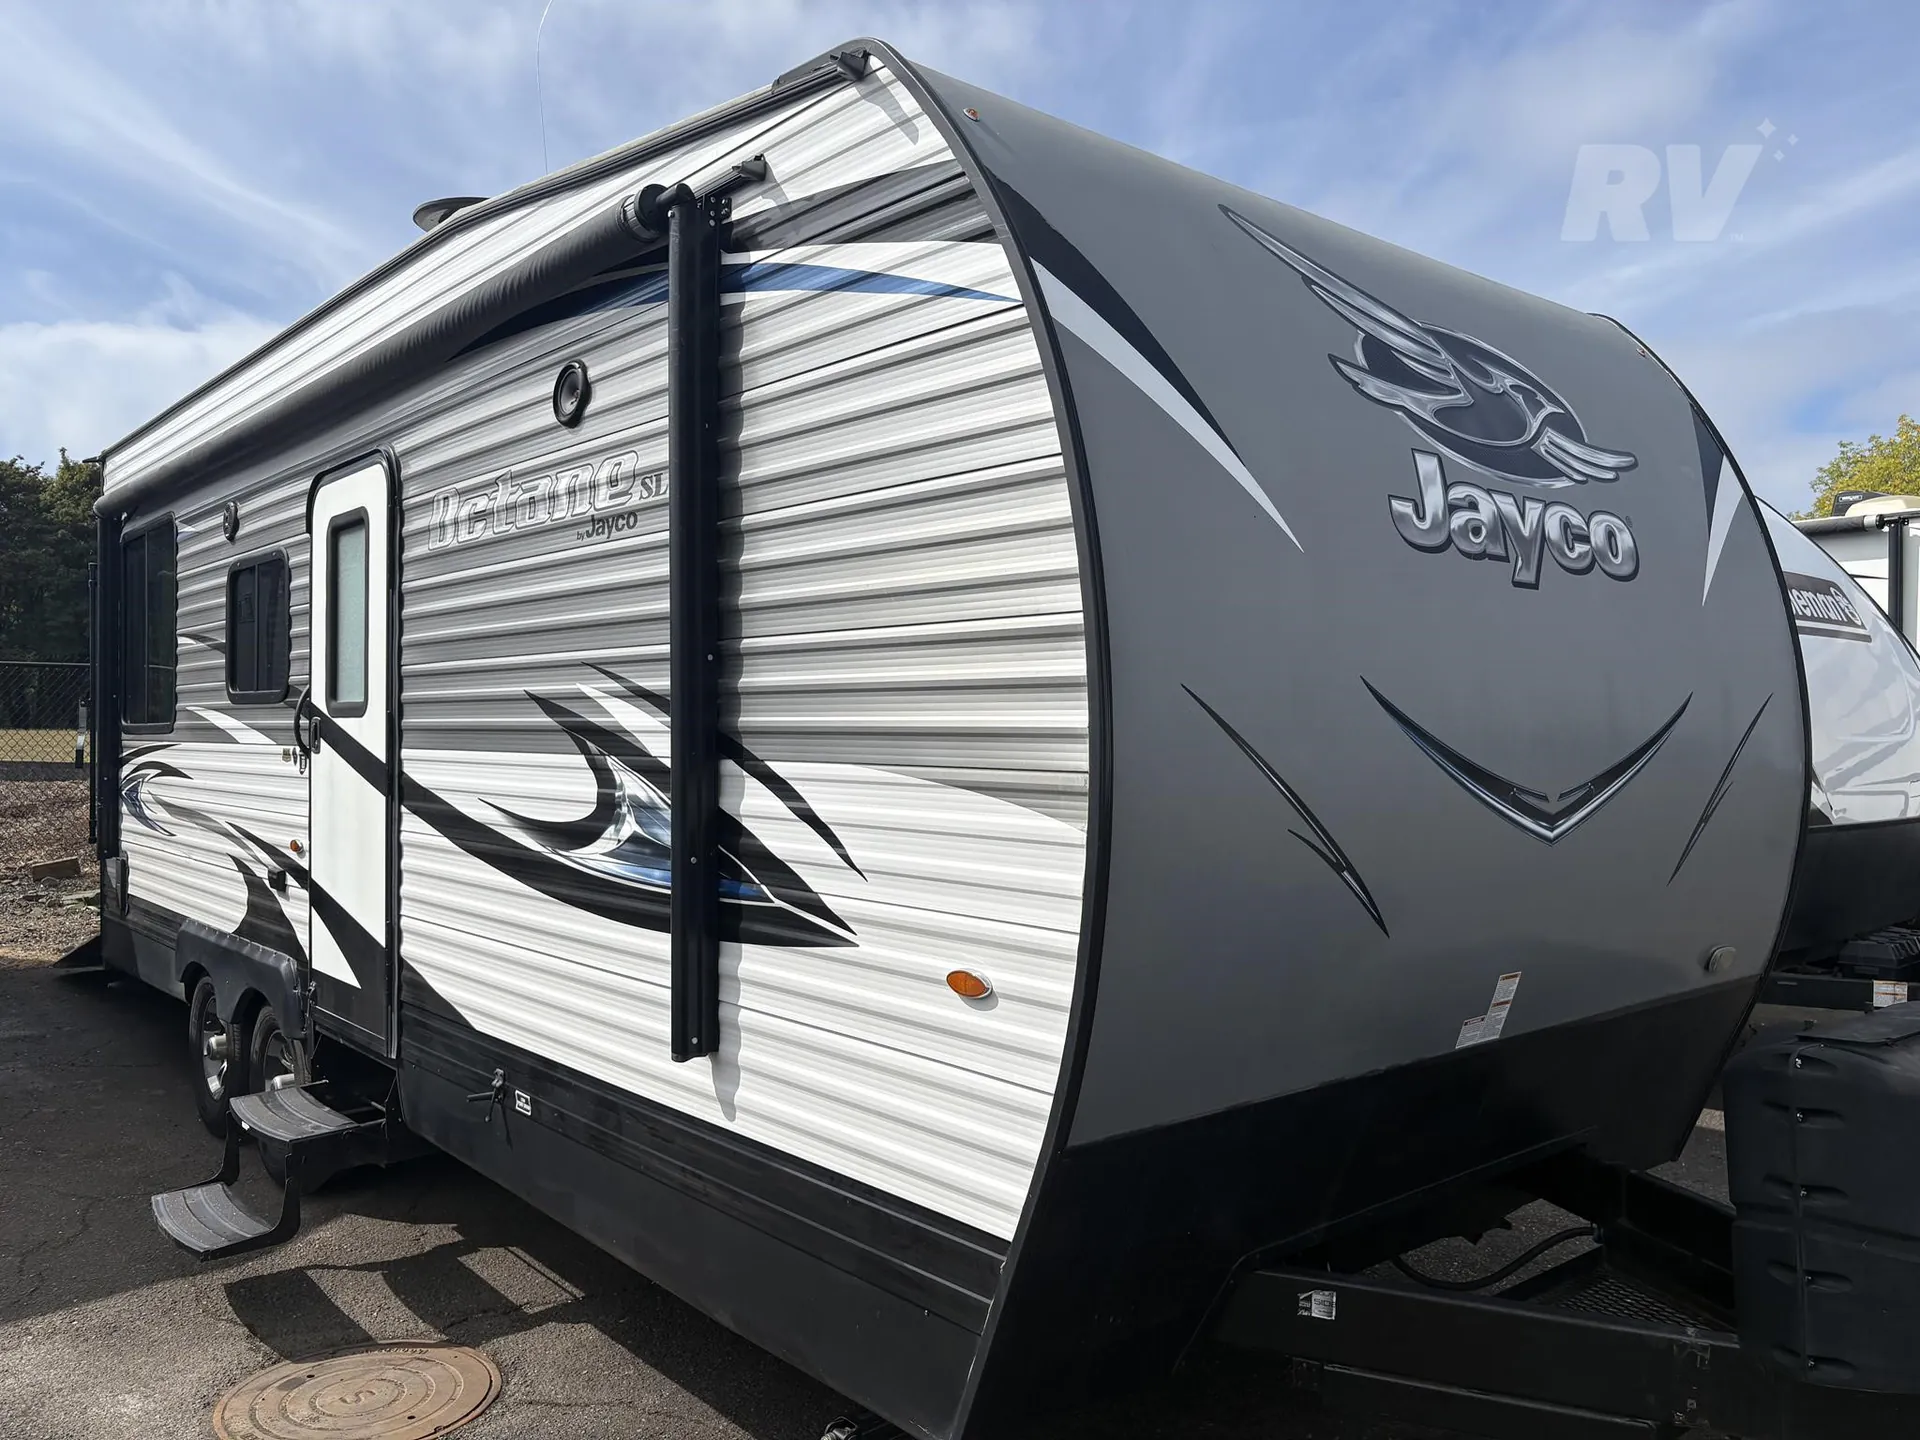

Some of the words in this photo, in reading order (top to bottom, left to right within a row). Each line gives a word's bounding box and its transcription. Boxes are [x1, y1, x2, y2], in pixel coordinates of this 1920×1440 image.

[428, 450, 639, 551] Octane
[638, 472, 668, 500] SL
[576, 531, 586, 541] by
[585, 511, 638, 539] Jayco
[1387, 447, 1640, 590] Jayco
[1788, 588, 1848, 622] leman
